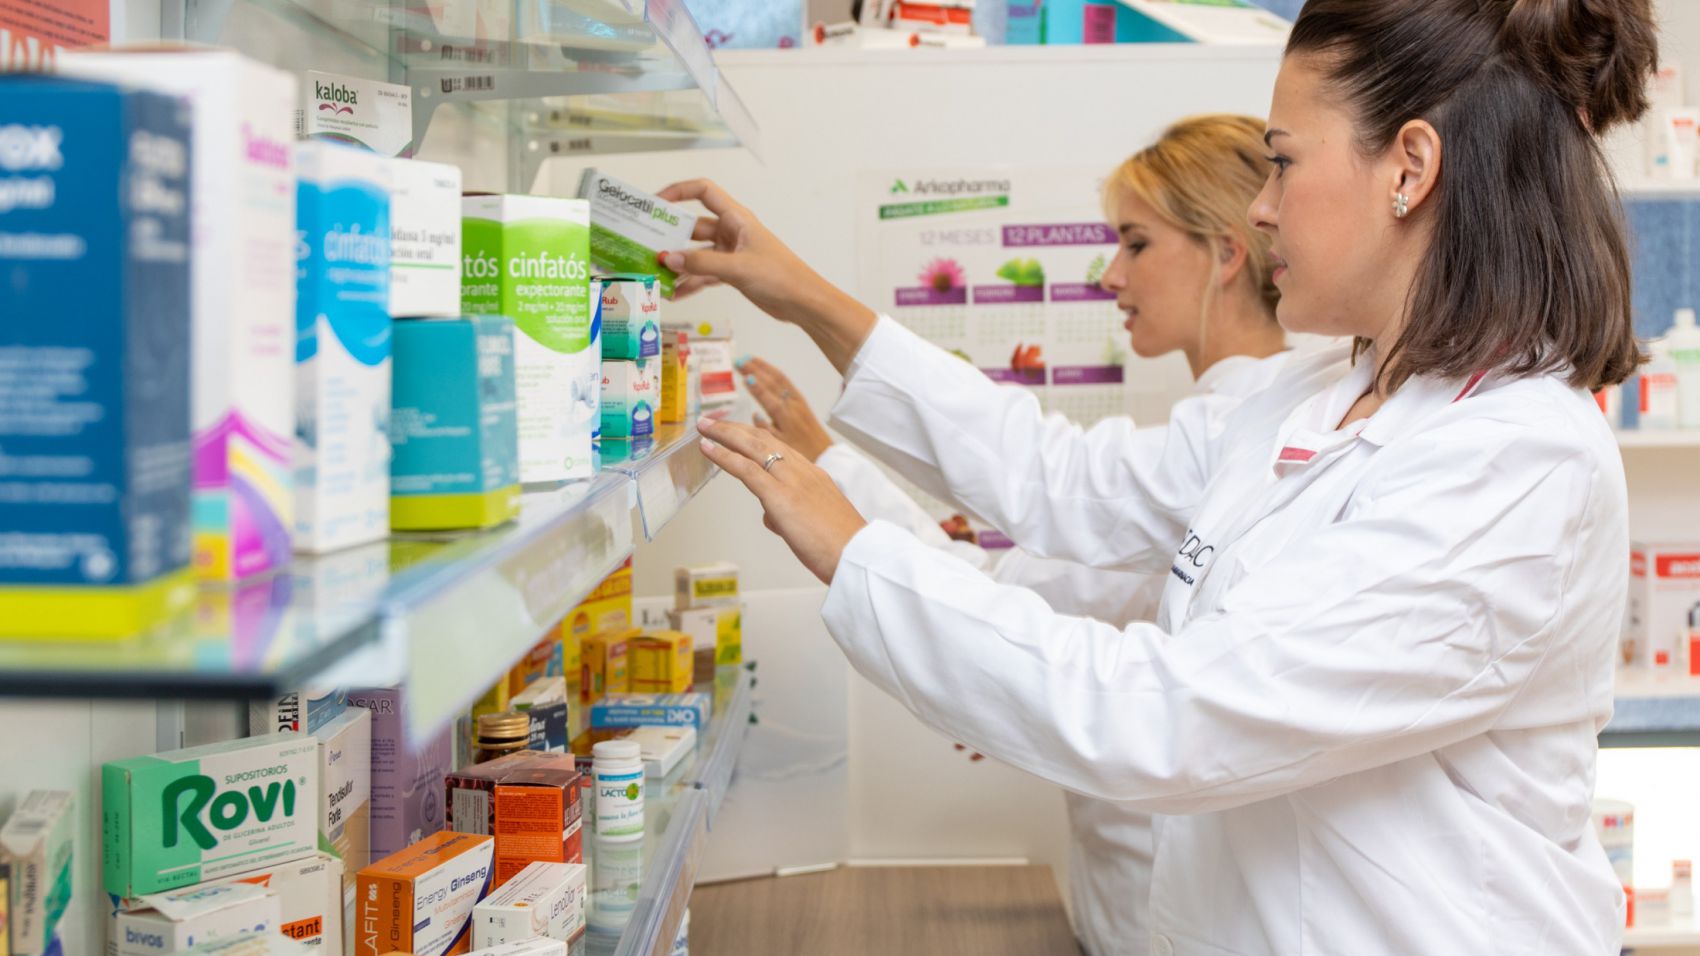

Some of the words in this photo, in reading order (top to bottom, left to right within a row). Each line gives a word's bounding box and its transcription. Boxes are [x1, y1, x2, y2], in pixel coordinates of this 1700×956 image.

[315, 80, 357, 105] kaloba
[914, 179, 1010, 196] Arkopharma
[598, 178, 655, 215] Gelocatil
[651, 206, 679, 226] plus
[920, 230, 935, 245] 12
[939, 228, 994, 245] MESES
[1007, 228, 1026, 243] 12
[1028, 224, 1107, 242] PLANTAS
[461, 250, 499, 278] tós
[508, 251, 587, 279] cinfatós
[461, 284, 498, 296] orante
[516, 284, 587, 298] expectorante
[225, 764, 289, 785] SUPOSITORIOS
[328, 804, 342, 828] Forte
[233, 827, 266, 840] GLICERINA
[267, 820, 295, 832] ADULTOS
[416, 887, 448, 911] Energy
[450, 866, 487, 893] Ginseng
[391, 882, 402, 941] Ginseng
[126, 927, 164, 949] bivos
[364, 901, 379, 956] AFIT
